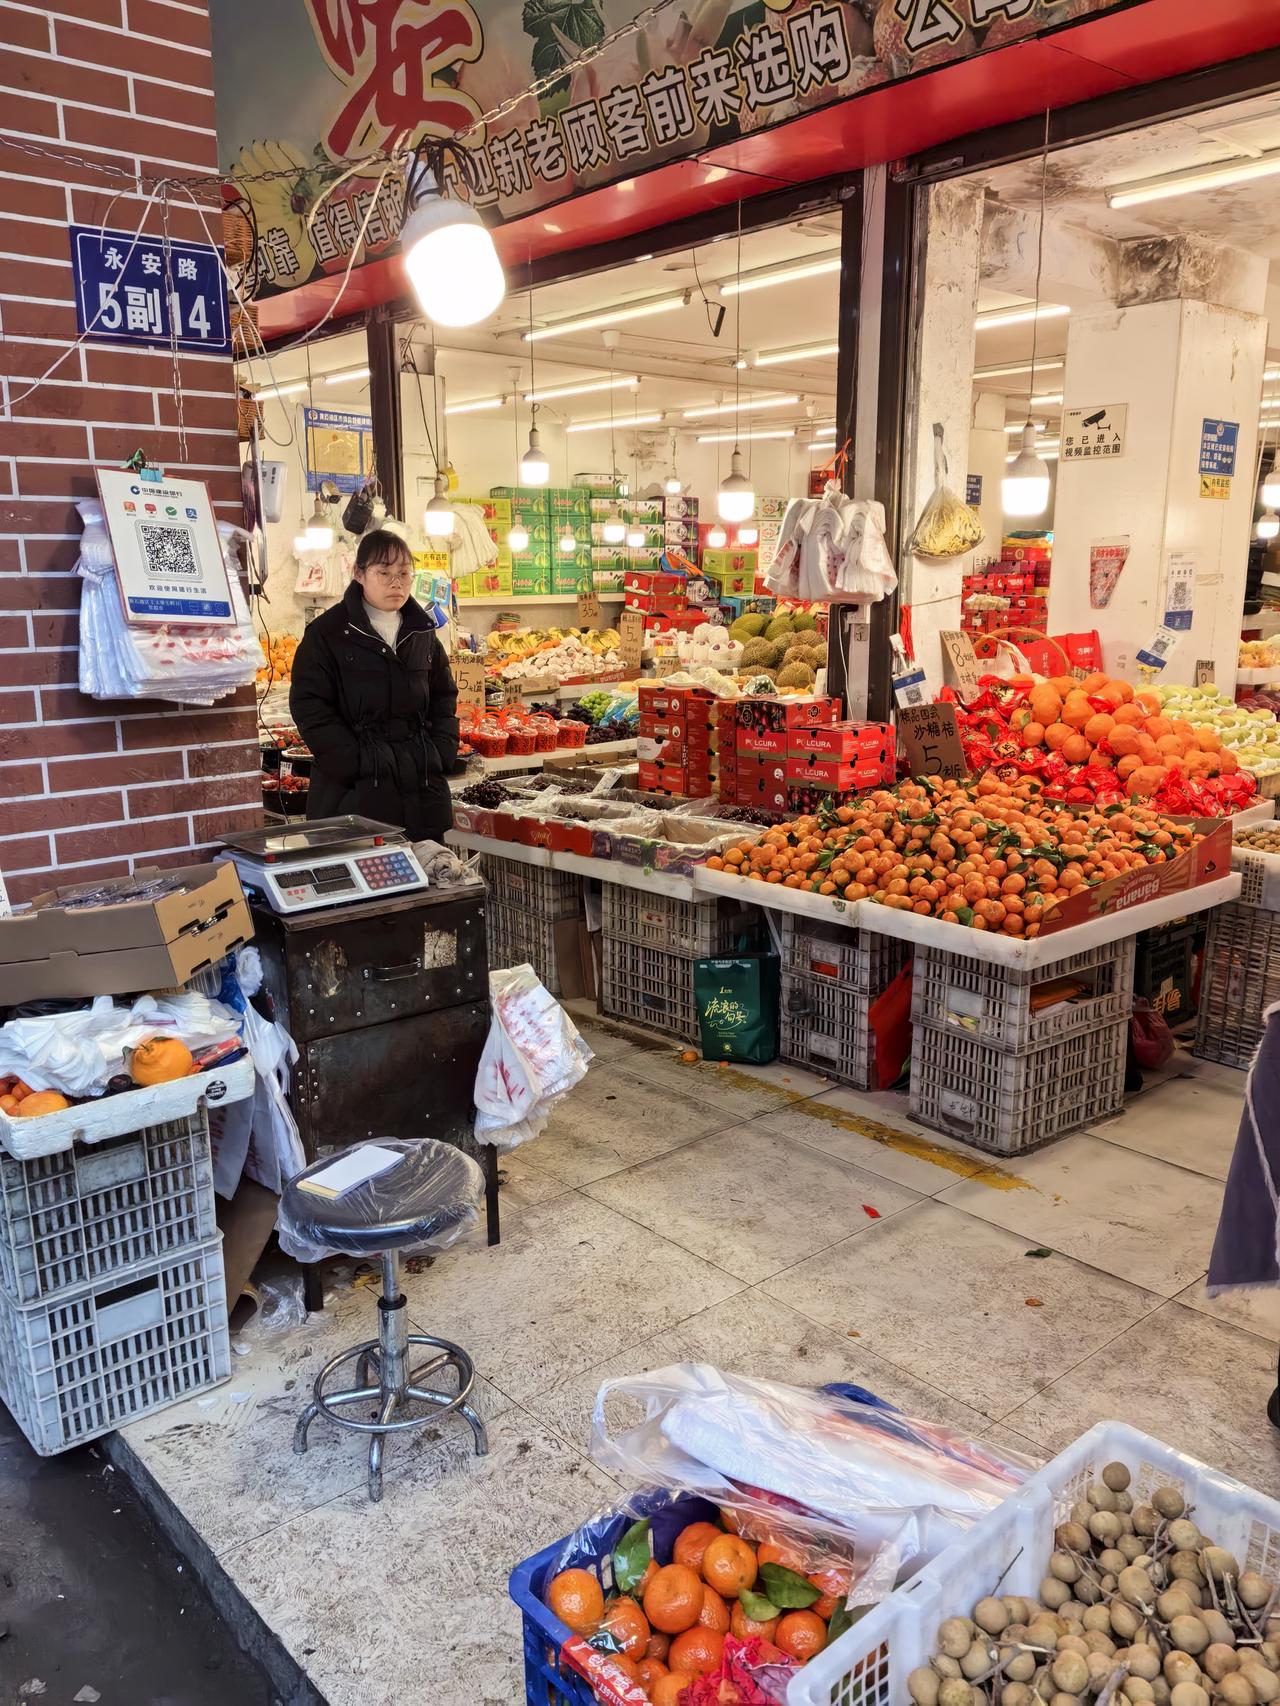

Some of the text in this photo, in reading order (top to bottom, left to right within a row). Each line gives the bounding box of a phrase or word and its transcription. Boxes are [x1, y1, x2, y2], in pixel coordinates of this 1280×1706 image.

[104, 247, 198, 281] 永安路
[98, 282, 212, 339] 5副14
[1064, 443, 1121, 457] 视频监控范围
[1065, 432, 1121, 446] 您已进入
[148, 584, 208, 594] 欢迎使用建行生活
[951, 642, 965, 667] 8
[454, 670, 470, 690] 15
[922, 745, 943, 775] 5
[1115, 878, 1160, 910] Banana
